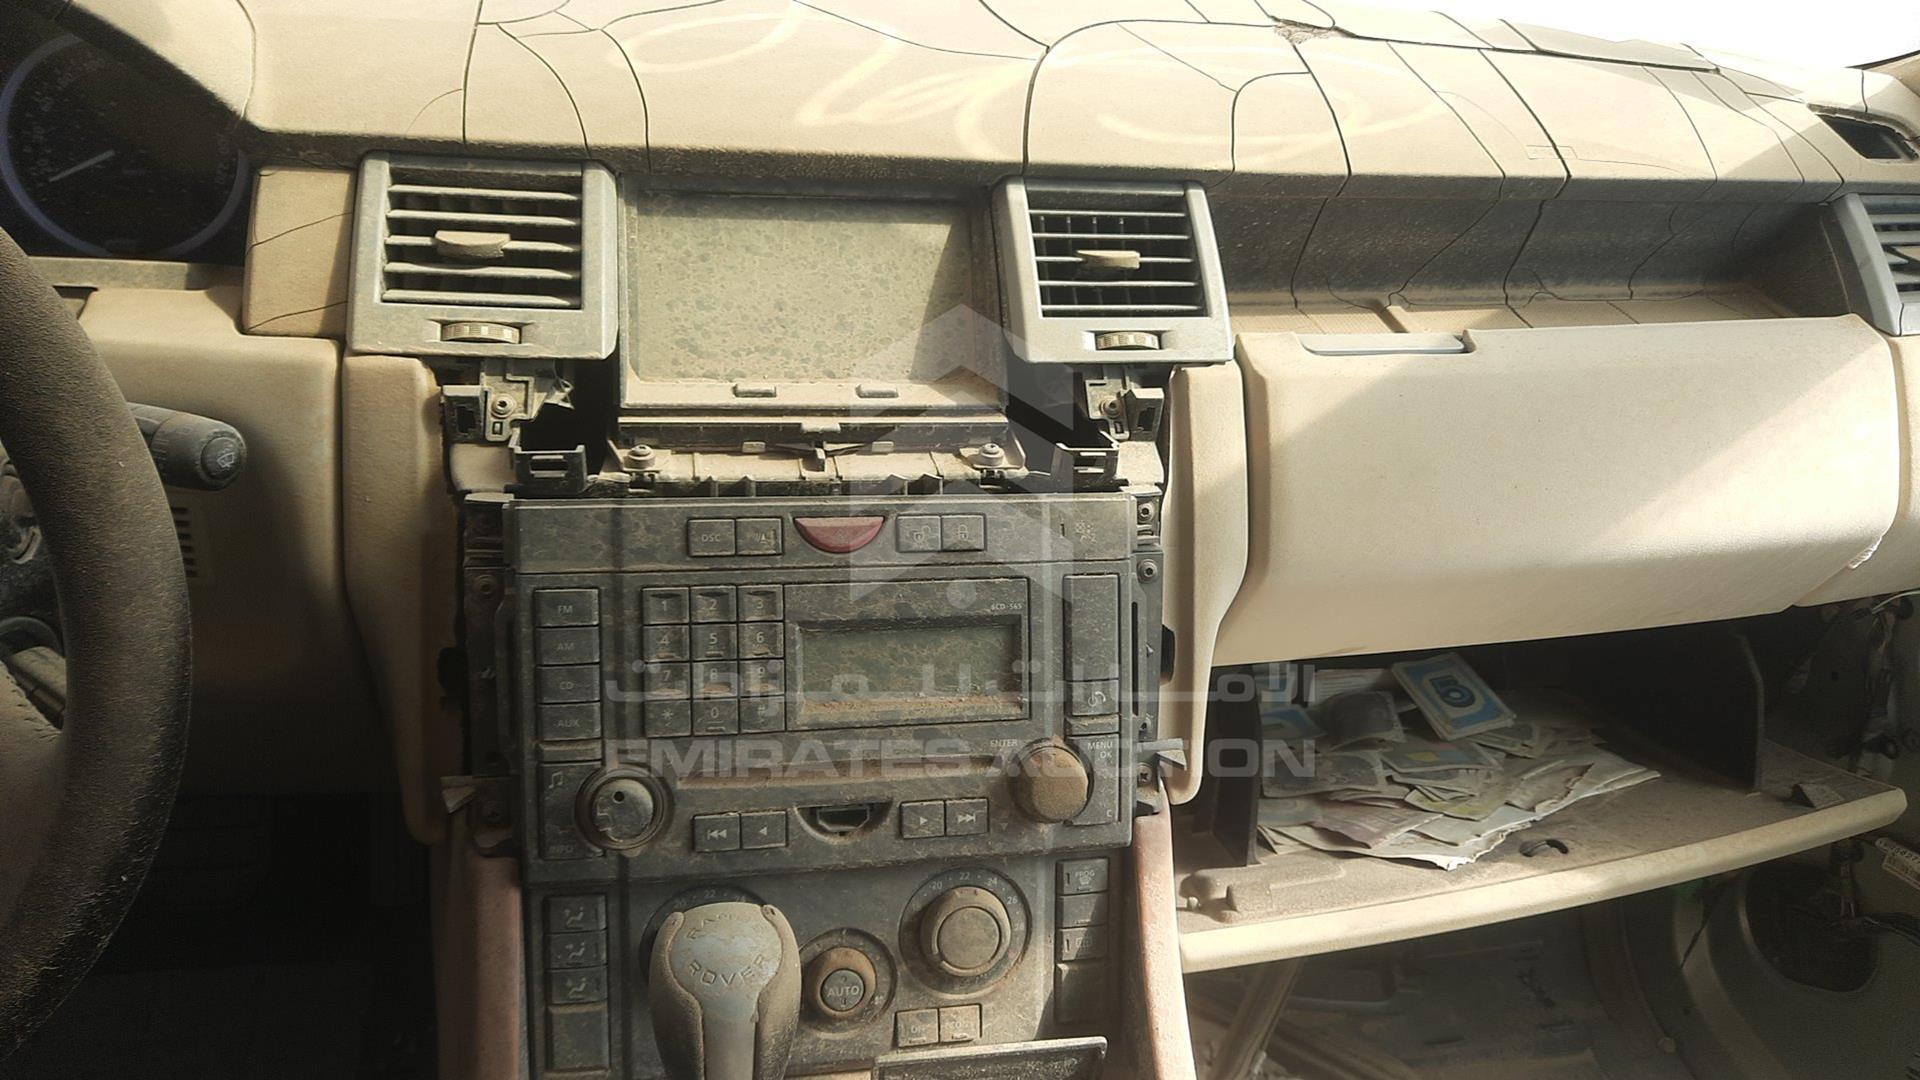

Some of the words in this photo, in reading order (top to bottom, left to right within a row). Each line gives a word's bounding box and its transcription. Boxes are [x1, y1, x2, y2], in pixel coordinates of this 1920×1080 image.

[701, 534, 721, 543] DSC
[661, 599, 668, 612] 1
[709, 599, 718, 610] 2
[755, 598, 764, 609] 3
[557, 605, 573, 614] FM
[659, 633, 669, 645] 4
[708, 633, 718, 644] 5
[756, 631, 765, 643] 6
[556, 642, 575, 651] AM
[662, 670, 672, 681] 7
[709, 668, 718, 680] 8
[559, 681, 574, 690] CD
[710, 708, 719, 719] 0
[557, 719, 580, 729] AUX
[990, 739, 1018, 748] ENTER
[1087, 741, 1113, 750] MENU
[1099, 751, 1112, 759] OK
[959, 872, 970, 881] 22
[930, 881, 943, 890] 20
[703, 890, 717, 899] 22
[1006, 896, 1019, 905] 26
[688, 953, 766, 987] ROVER
[826, 985, 861, 998] AUTO
